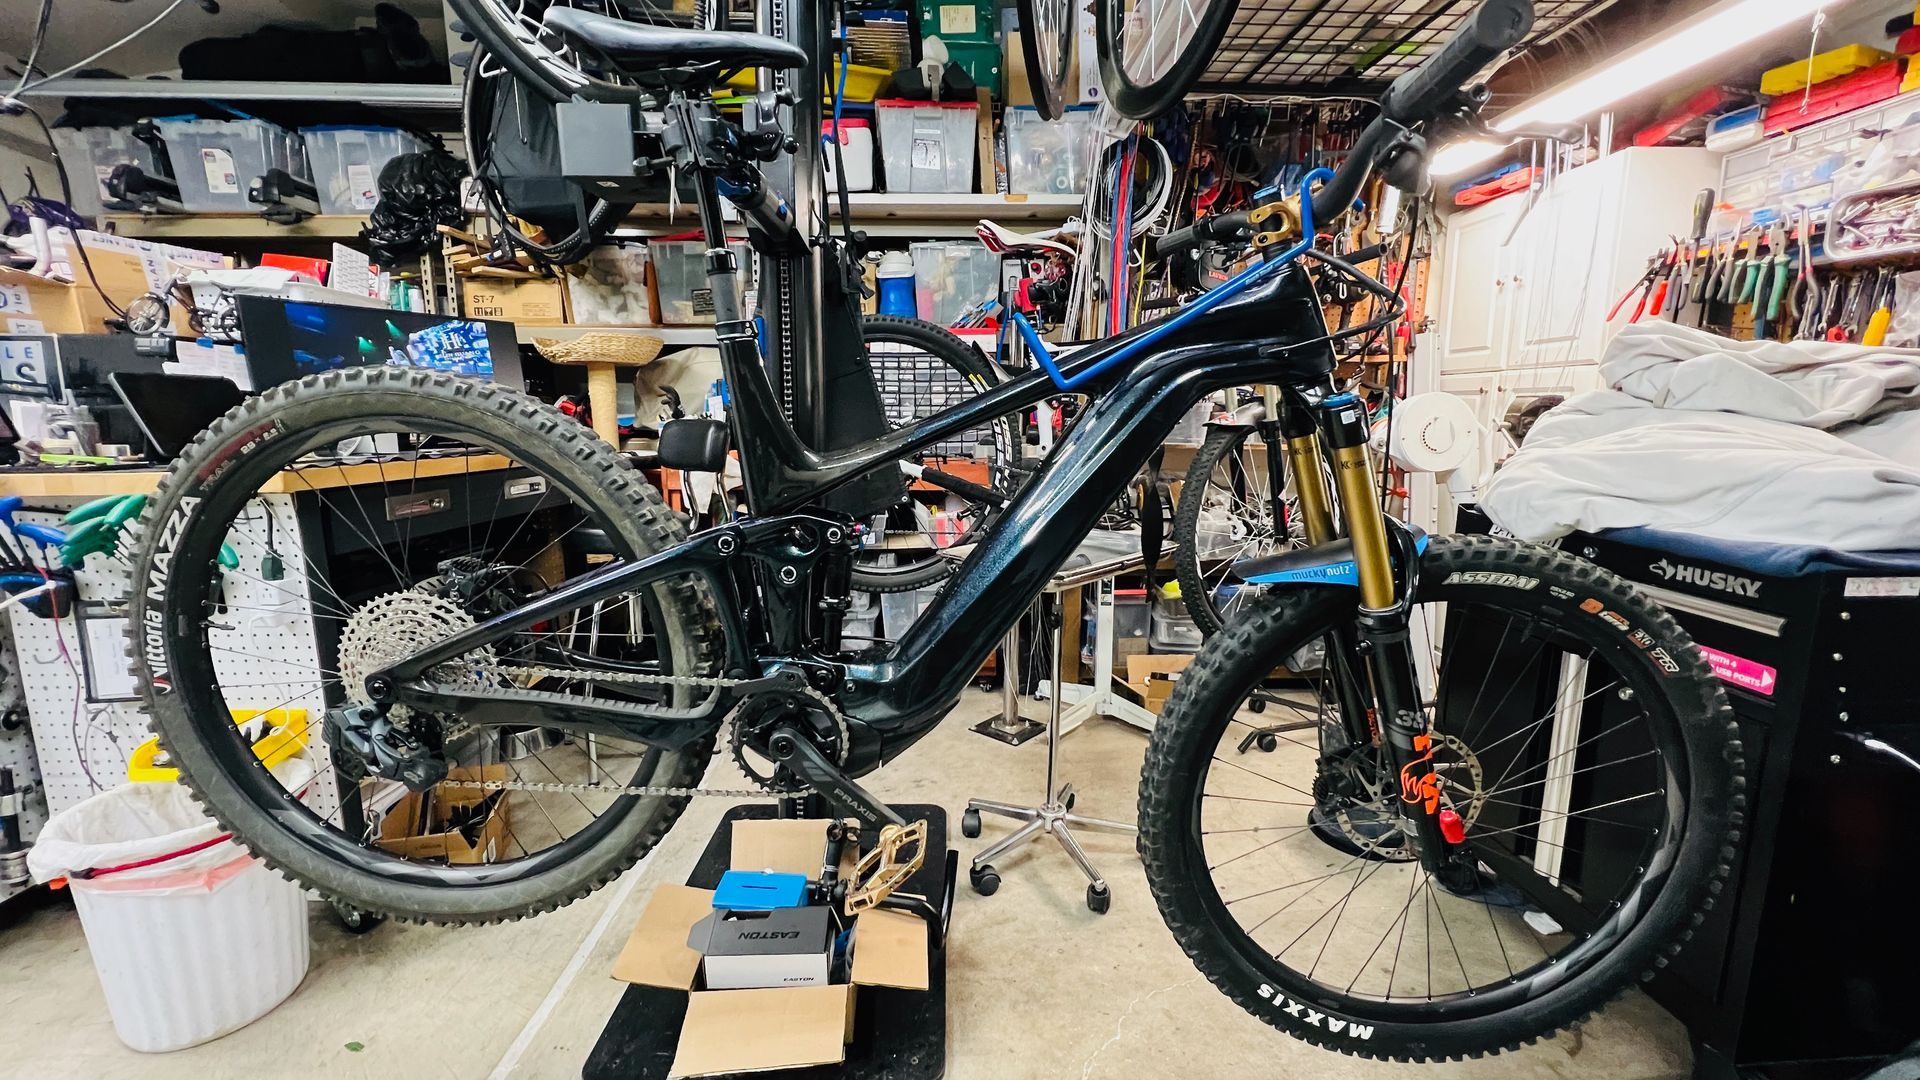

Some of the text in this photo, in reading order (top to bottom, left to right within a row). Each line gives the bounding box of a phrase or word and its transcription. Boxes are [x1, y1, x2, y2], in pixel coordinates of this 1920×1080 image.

[473, 294, 494, 304] ST-7
[147, 496, 201, 601] MAZZA
[1442, 571, 1540, 591] ASSEGAI
[1676, 564, 1762, 598] HUSKY
[1730, 660, 1737, 668] 4
[834, 787, 878, 822] PRAXIS
[738, 931, 800, 940] EASTON
[1257, 983, 1375, 1040] MAXXIS
